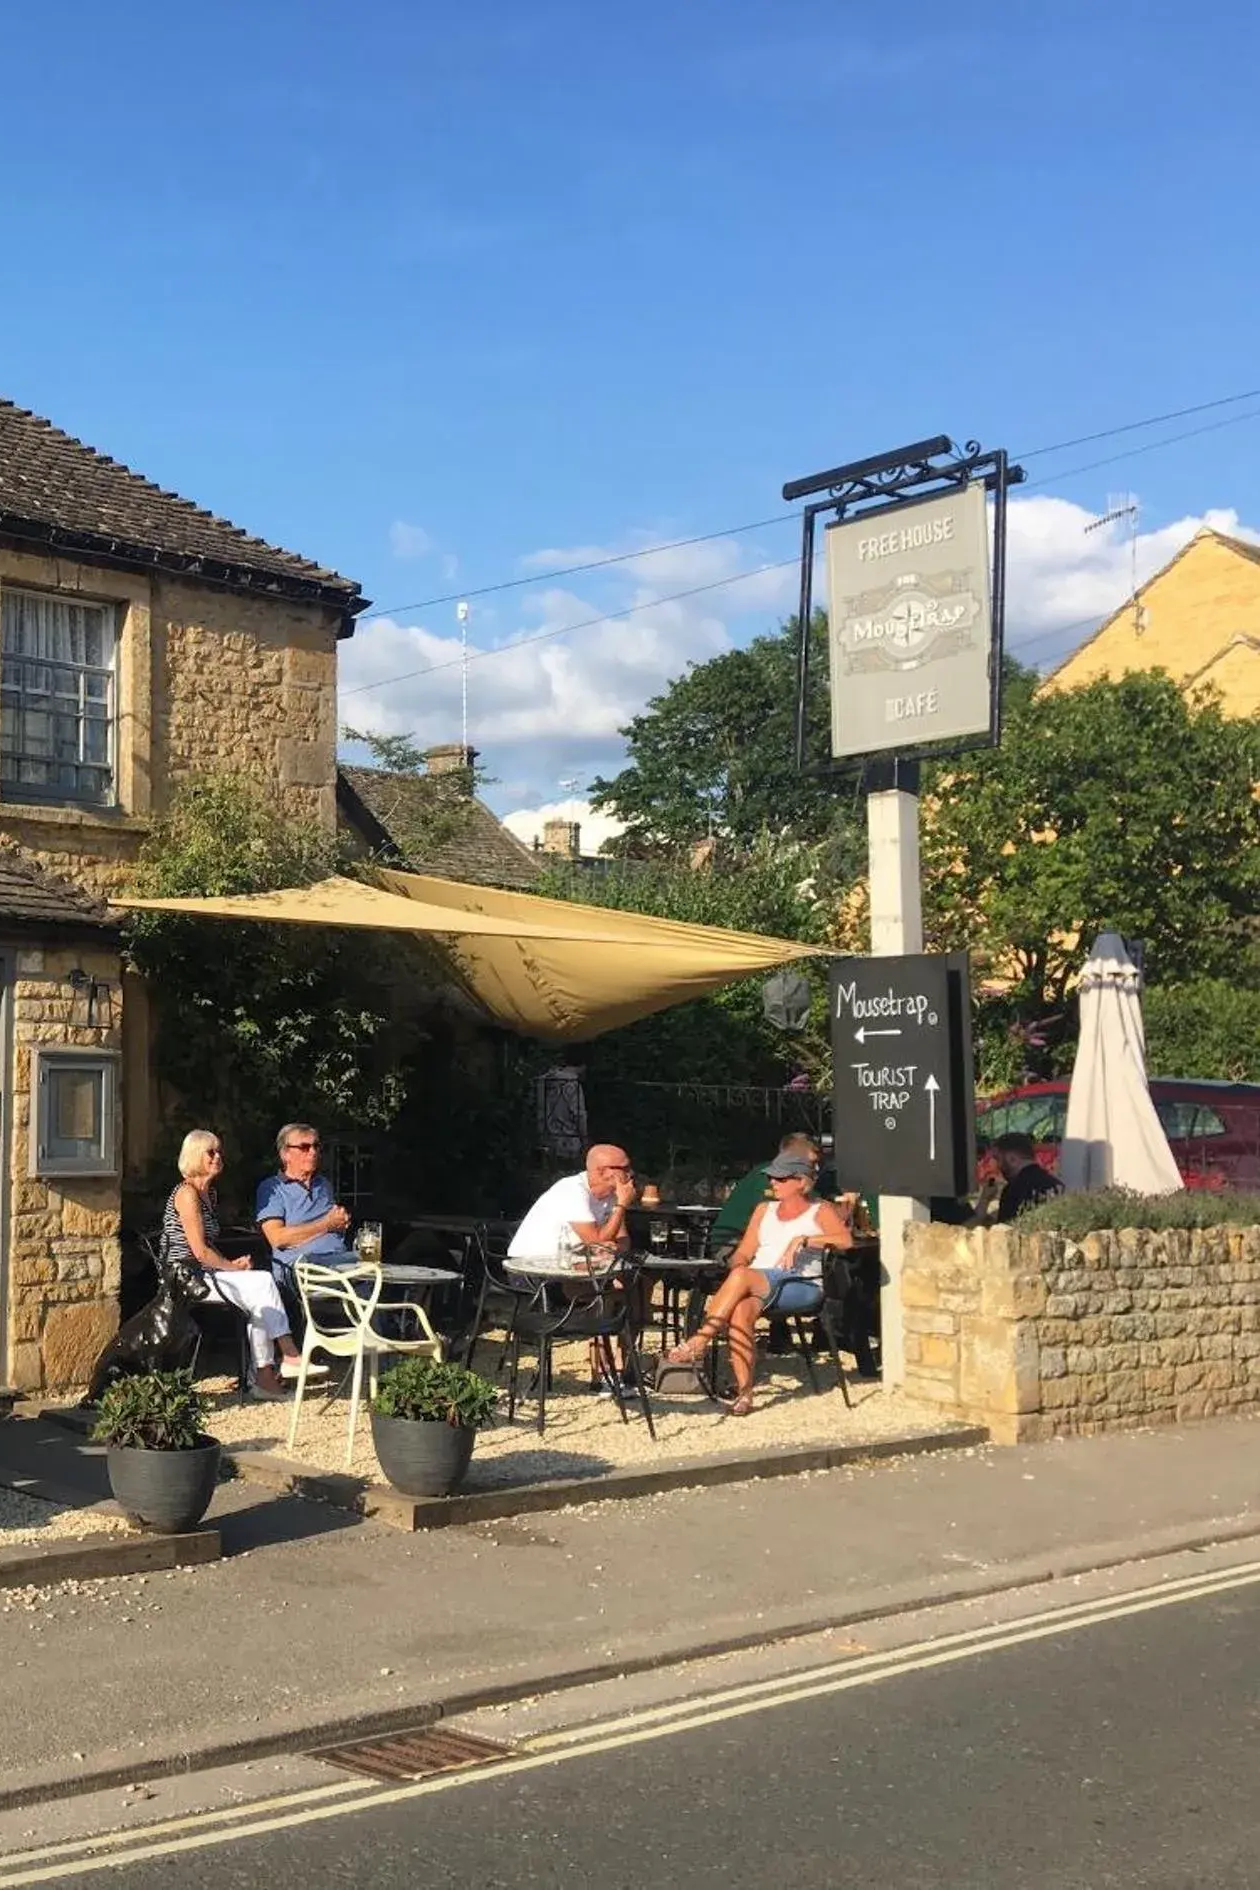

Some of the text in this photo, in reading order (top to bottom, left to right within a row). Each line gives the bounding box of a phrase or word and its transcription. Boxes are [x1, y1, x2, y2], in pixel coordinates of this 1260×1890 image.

[836, 981, 928, 1025] Mousetrap
[850, 1062, 918, 1088] TOURIST
[868, 1091, 910, 1110] TRAP
